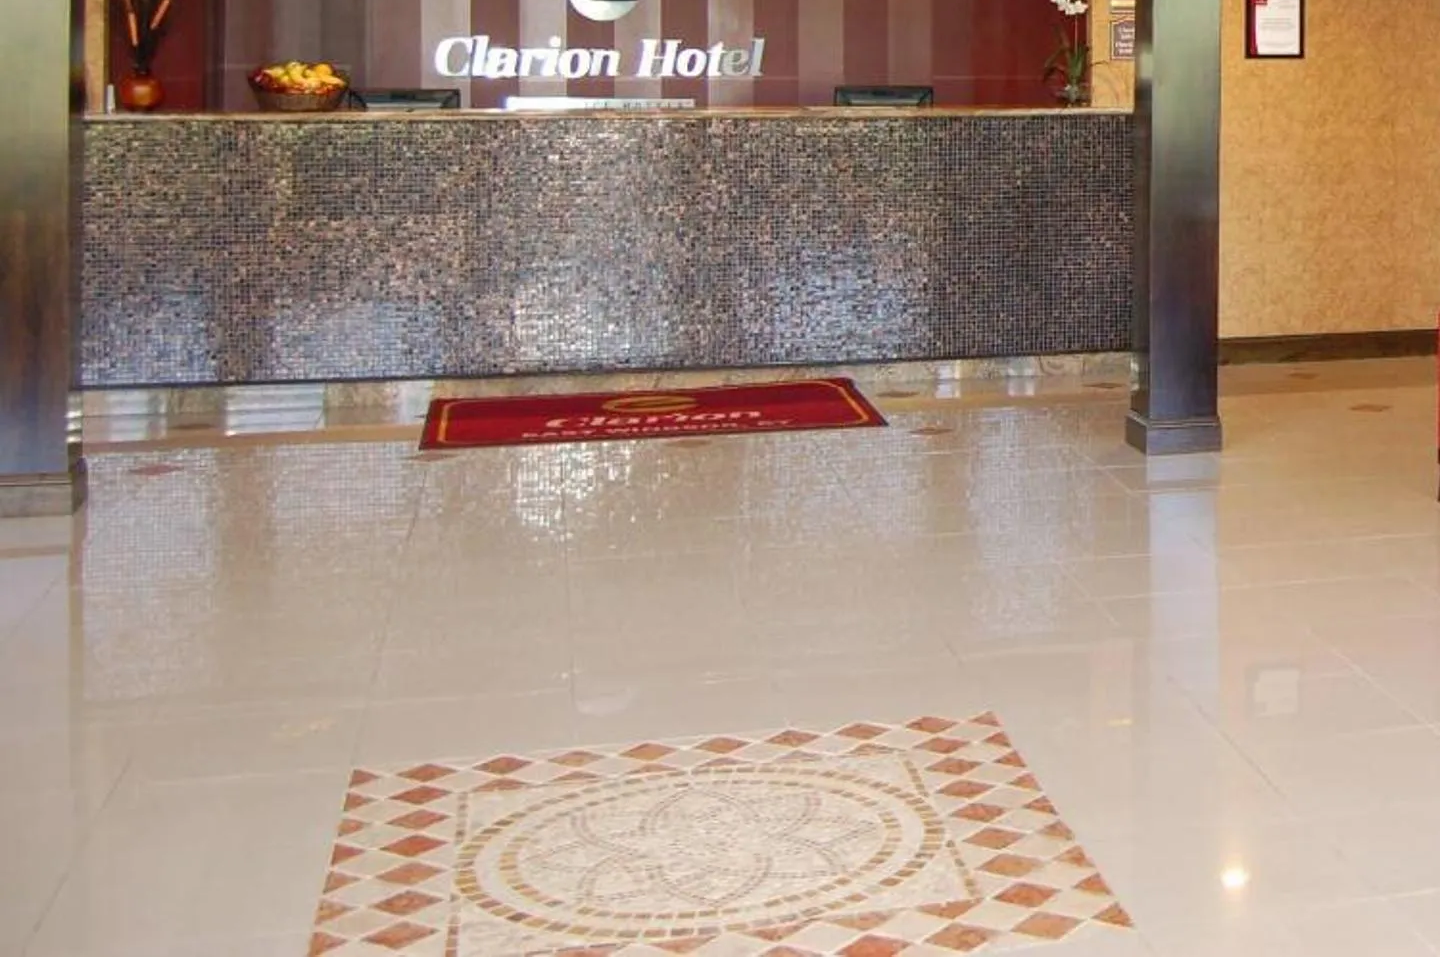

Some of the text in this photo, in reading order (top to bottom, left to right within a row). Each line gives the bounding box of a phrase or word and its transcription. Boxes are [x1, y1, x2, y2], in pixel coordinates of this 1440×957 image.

[434, 35, 765, 79] Clarion Hotel
[545, 410, 762, 429] Clarion
